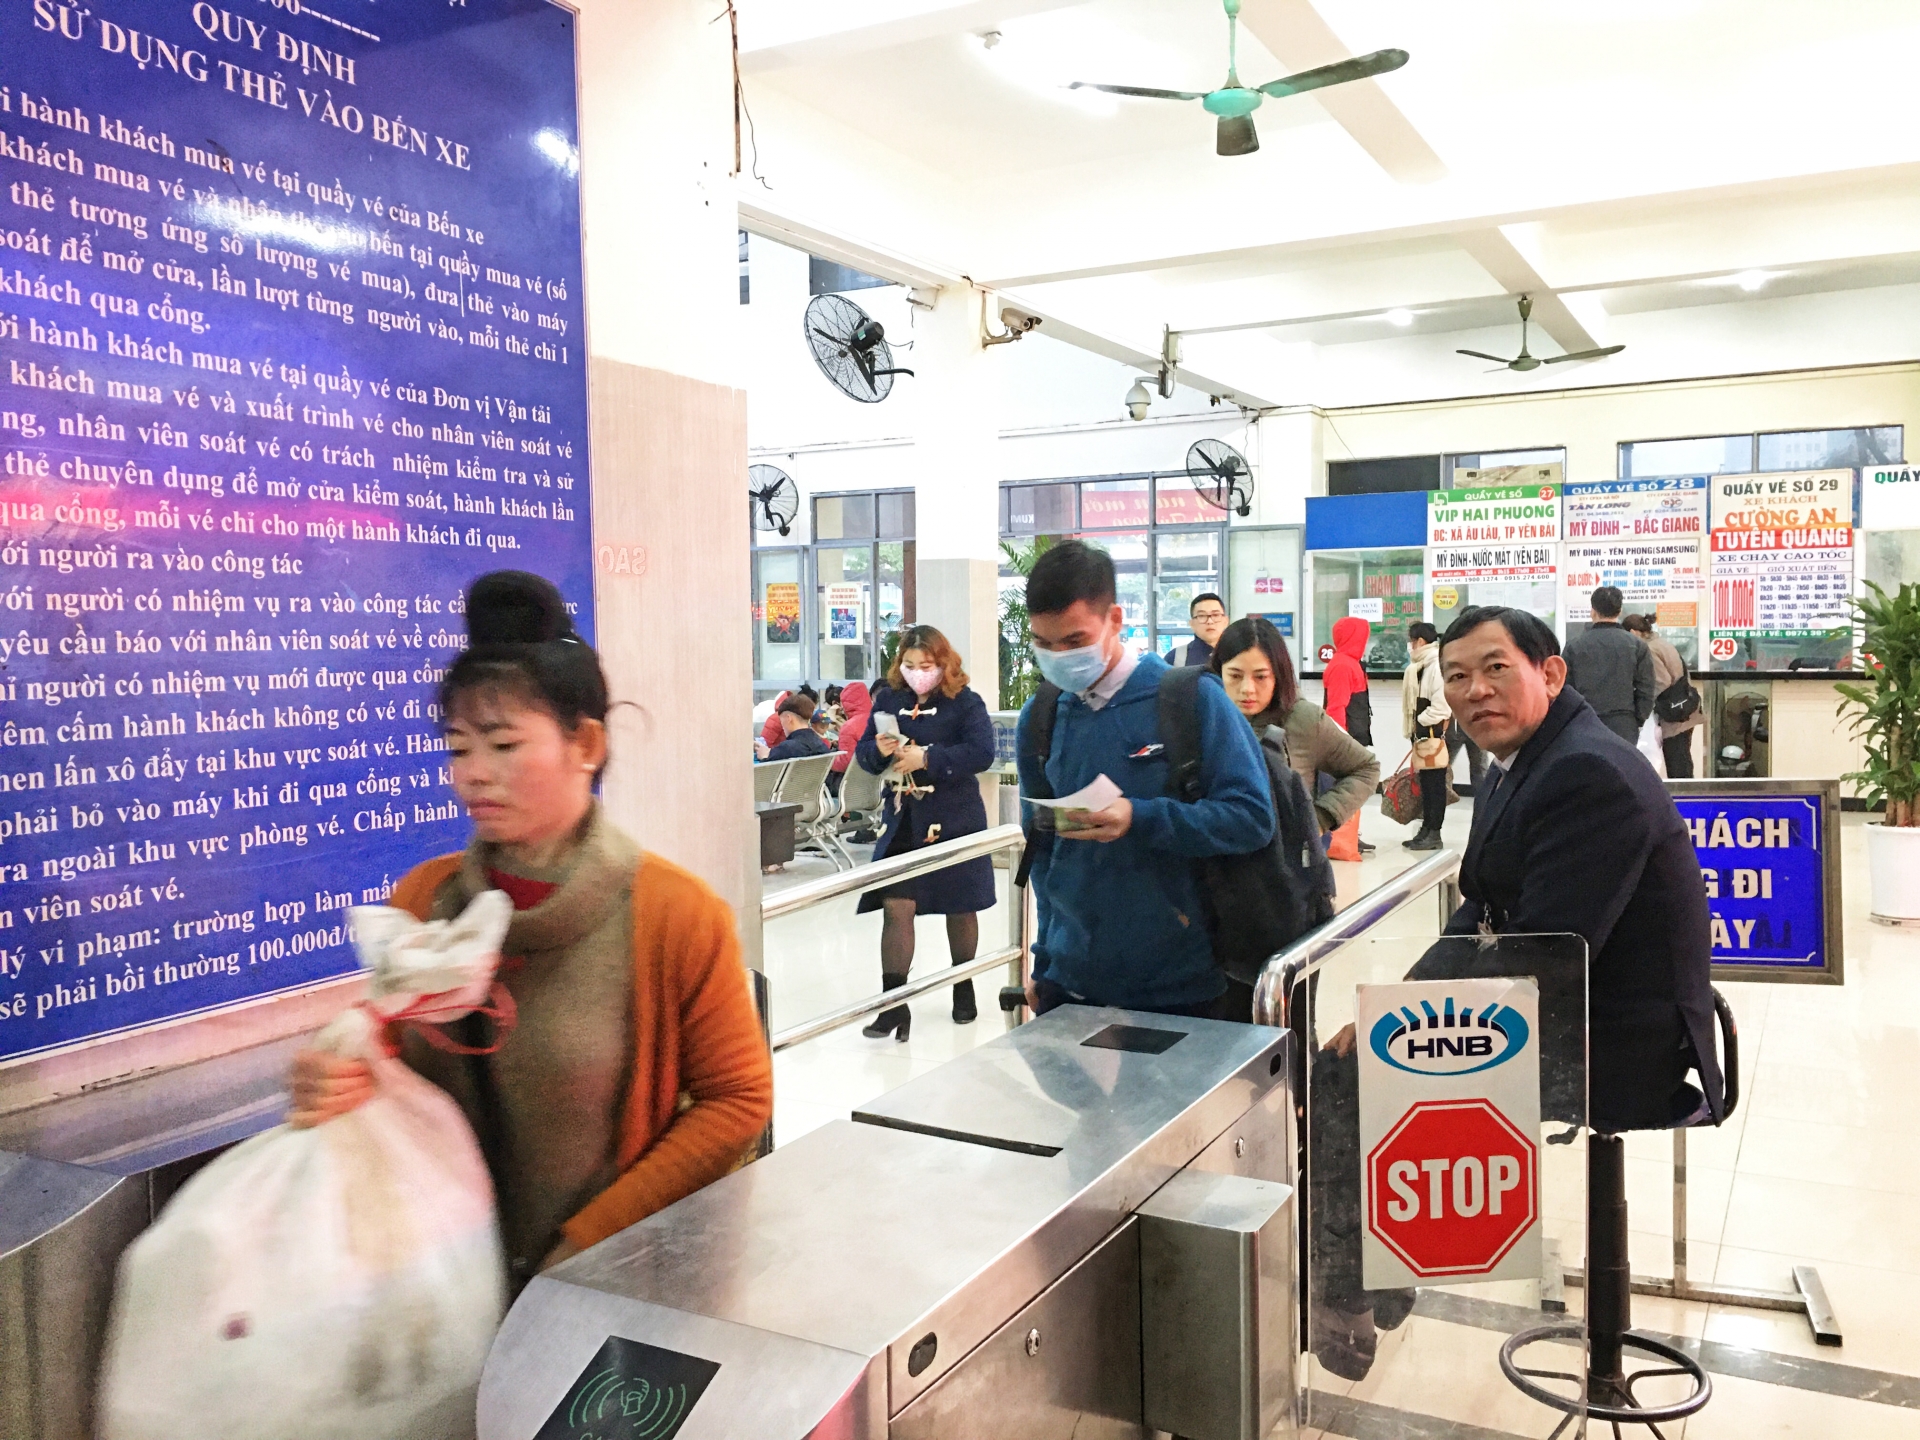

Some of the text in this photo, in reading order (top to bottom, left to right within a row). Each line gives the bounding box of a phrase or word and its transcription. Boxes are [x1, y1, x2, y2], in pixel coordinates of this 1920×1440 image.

[192, 2, 267, 51] QUY
[276, 30, 356, 86] ĐỊNH
[34, 0, 471, 171] SỬ DỤNG THẺ VÀO BẾN XE
[0, 268, 210, 334] khách qua cổng.
[30, 318, 550, 424] hành khách mua vé tại quầy vé của Đơn vị Vận tải
[5, 451, 574, 521] thẻ chuyên dụng để mở cửa kiểm soát, hành khách lần
[1540, 489, 1554, 499] 27
[1663, 478, 1694, 489] 28
[1769, 480, 1787, 493] VÉ
[1793, 476, 1814, 492] SỐ
[1819, 479, 1838, 491] 29
[1744, 497, 1763, 505] XE
[1434, 509, 1458, 522] VIP
[1569, 515, 1700, 537] MỸ ĐÌNH BẮC GIANG
[1725, 506, 1837, 527] CƯỜNG AN
[1434, 529, 1448, 542] ĐC:
[1505, 526, 1515, 539] TP
[1716, 527, 1848, 549] TUYÊN QUANG
[1608, 558, 1626, 567] NINH
[1652, 557, 1677, 566] GIANG
[1717, 554, 1737, 562] XE
[1784, 552, 1814, 560] CAO
[0, 624, 469, 662] yêu cầu báo với nhân viên soát vé về công
[1321, 649, 1333, 659] 26
[1713, 639, 1734, 655] 29
[0, 767, 430, 844] phải bỏ vào máy khi đi qua cổng và
[1684, 812, 1790, 849] HÁCH
[1732, 868, 1772, 899] ĐI
[0, 874, 398, 979] lý vi phạm: trường hợp làm mất
[1711, 912, 1756, 949] ÀY
[1408, 1035, 1493, 1059] HNB
[1387, 1155, 1520, 1222] STOP
